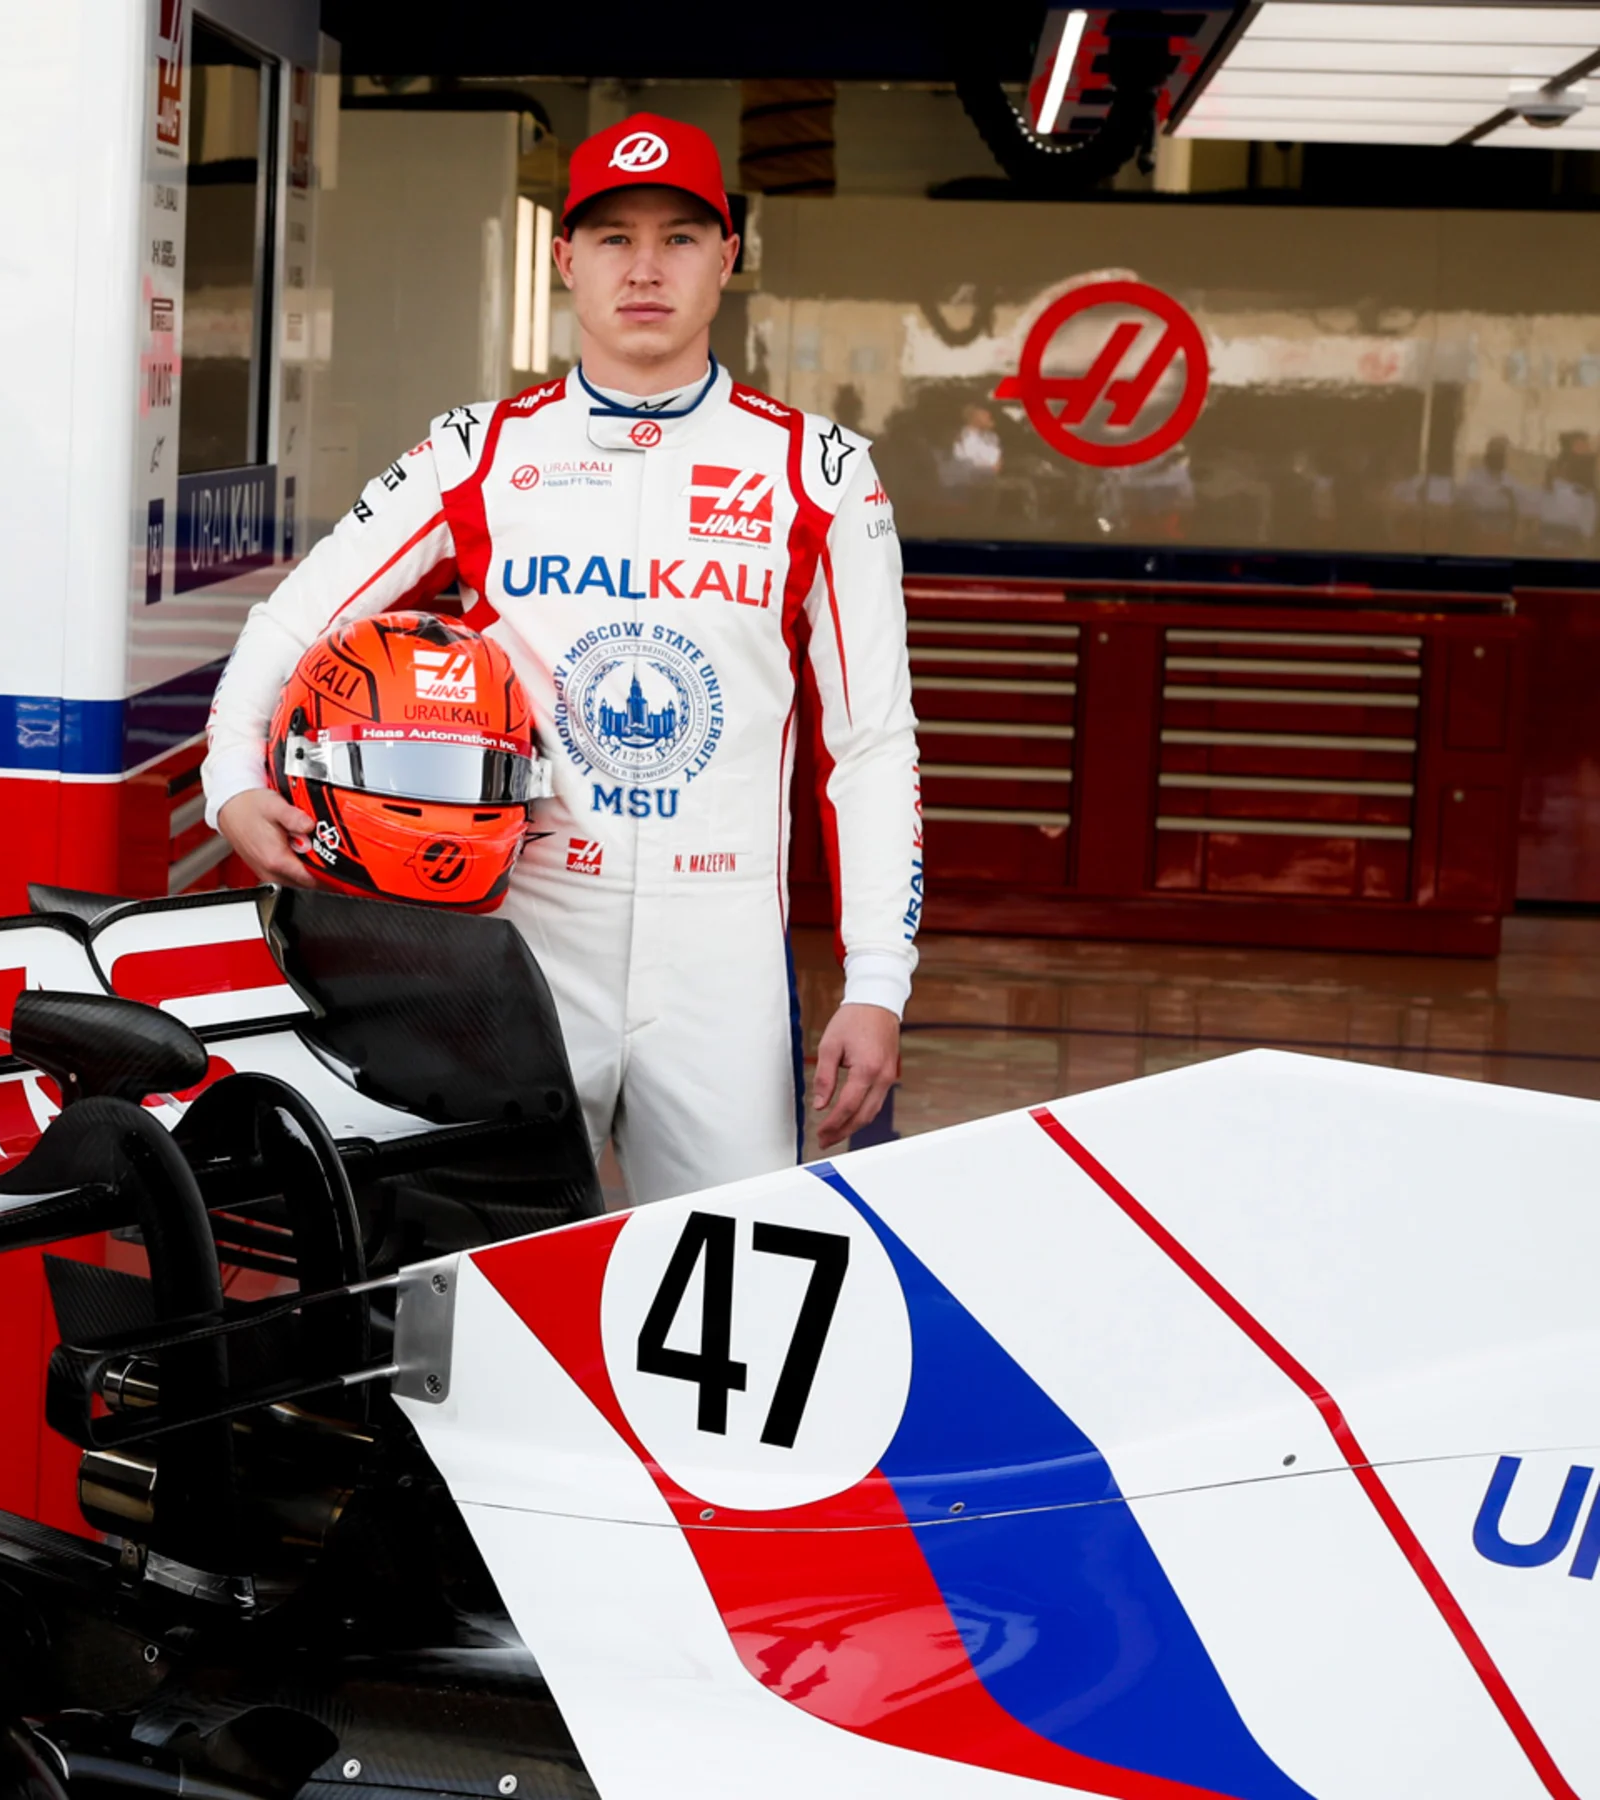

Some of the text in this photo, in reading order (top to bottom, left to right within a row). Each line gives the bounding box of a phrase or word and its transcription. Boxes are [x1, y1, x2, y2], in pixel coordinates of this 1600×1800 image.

[542, 460, 613, 473] URALKALI
[190, 480, 265, 571] URALKALI
[689, 513, 773, 539] HAAS
[502, 554, 774, 609] URALKALI
[404, 704, 491, 727] URALKALI
[564, 621, 644, 665] MOSCOW
[651, 624, 706, 665] STATE
[683, 664, 725, 784] UNIVERSITY
[362, 727, 518, 752] Haas Automation Inc.
[591, 783, 680, 819] MSU
[673, 852, 736, 873] N. MAZEPIN
[636, 1210, 851, 1450] 47
